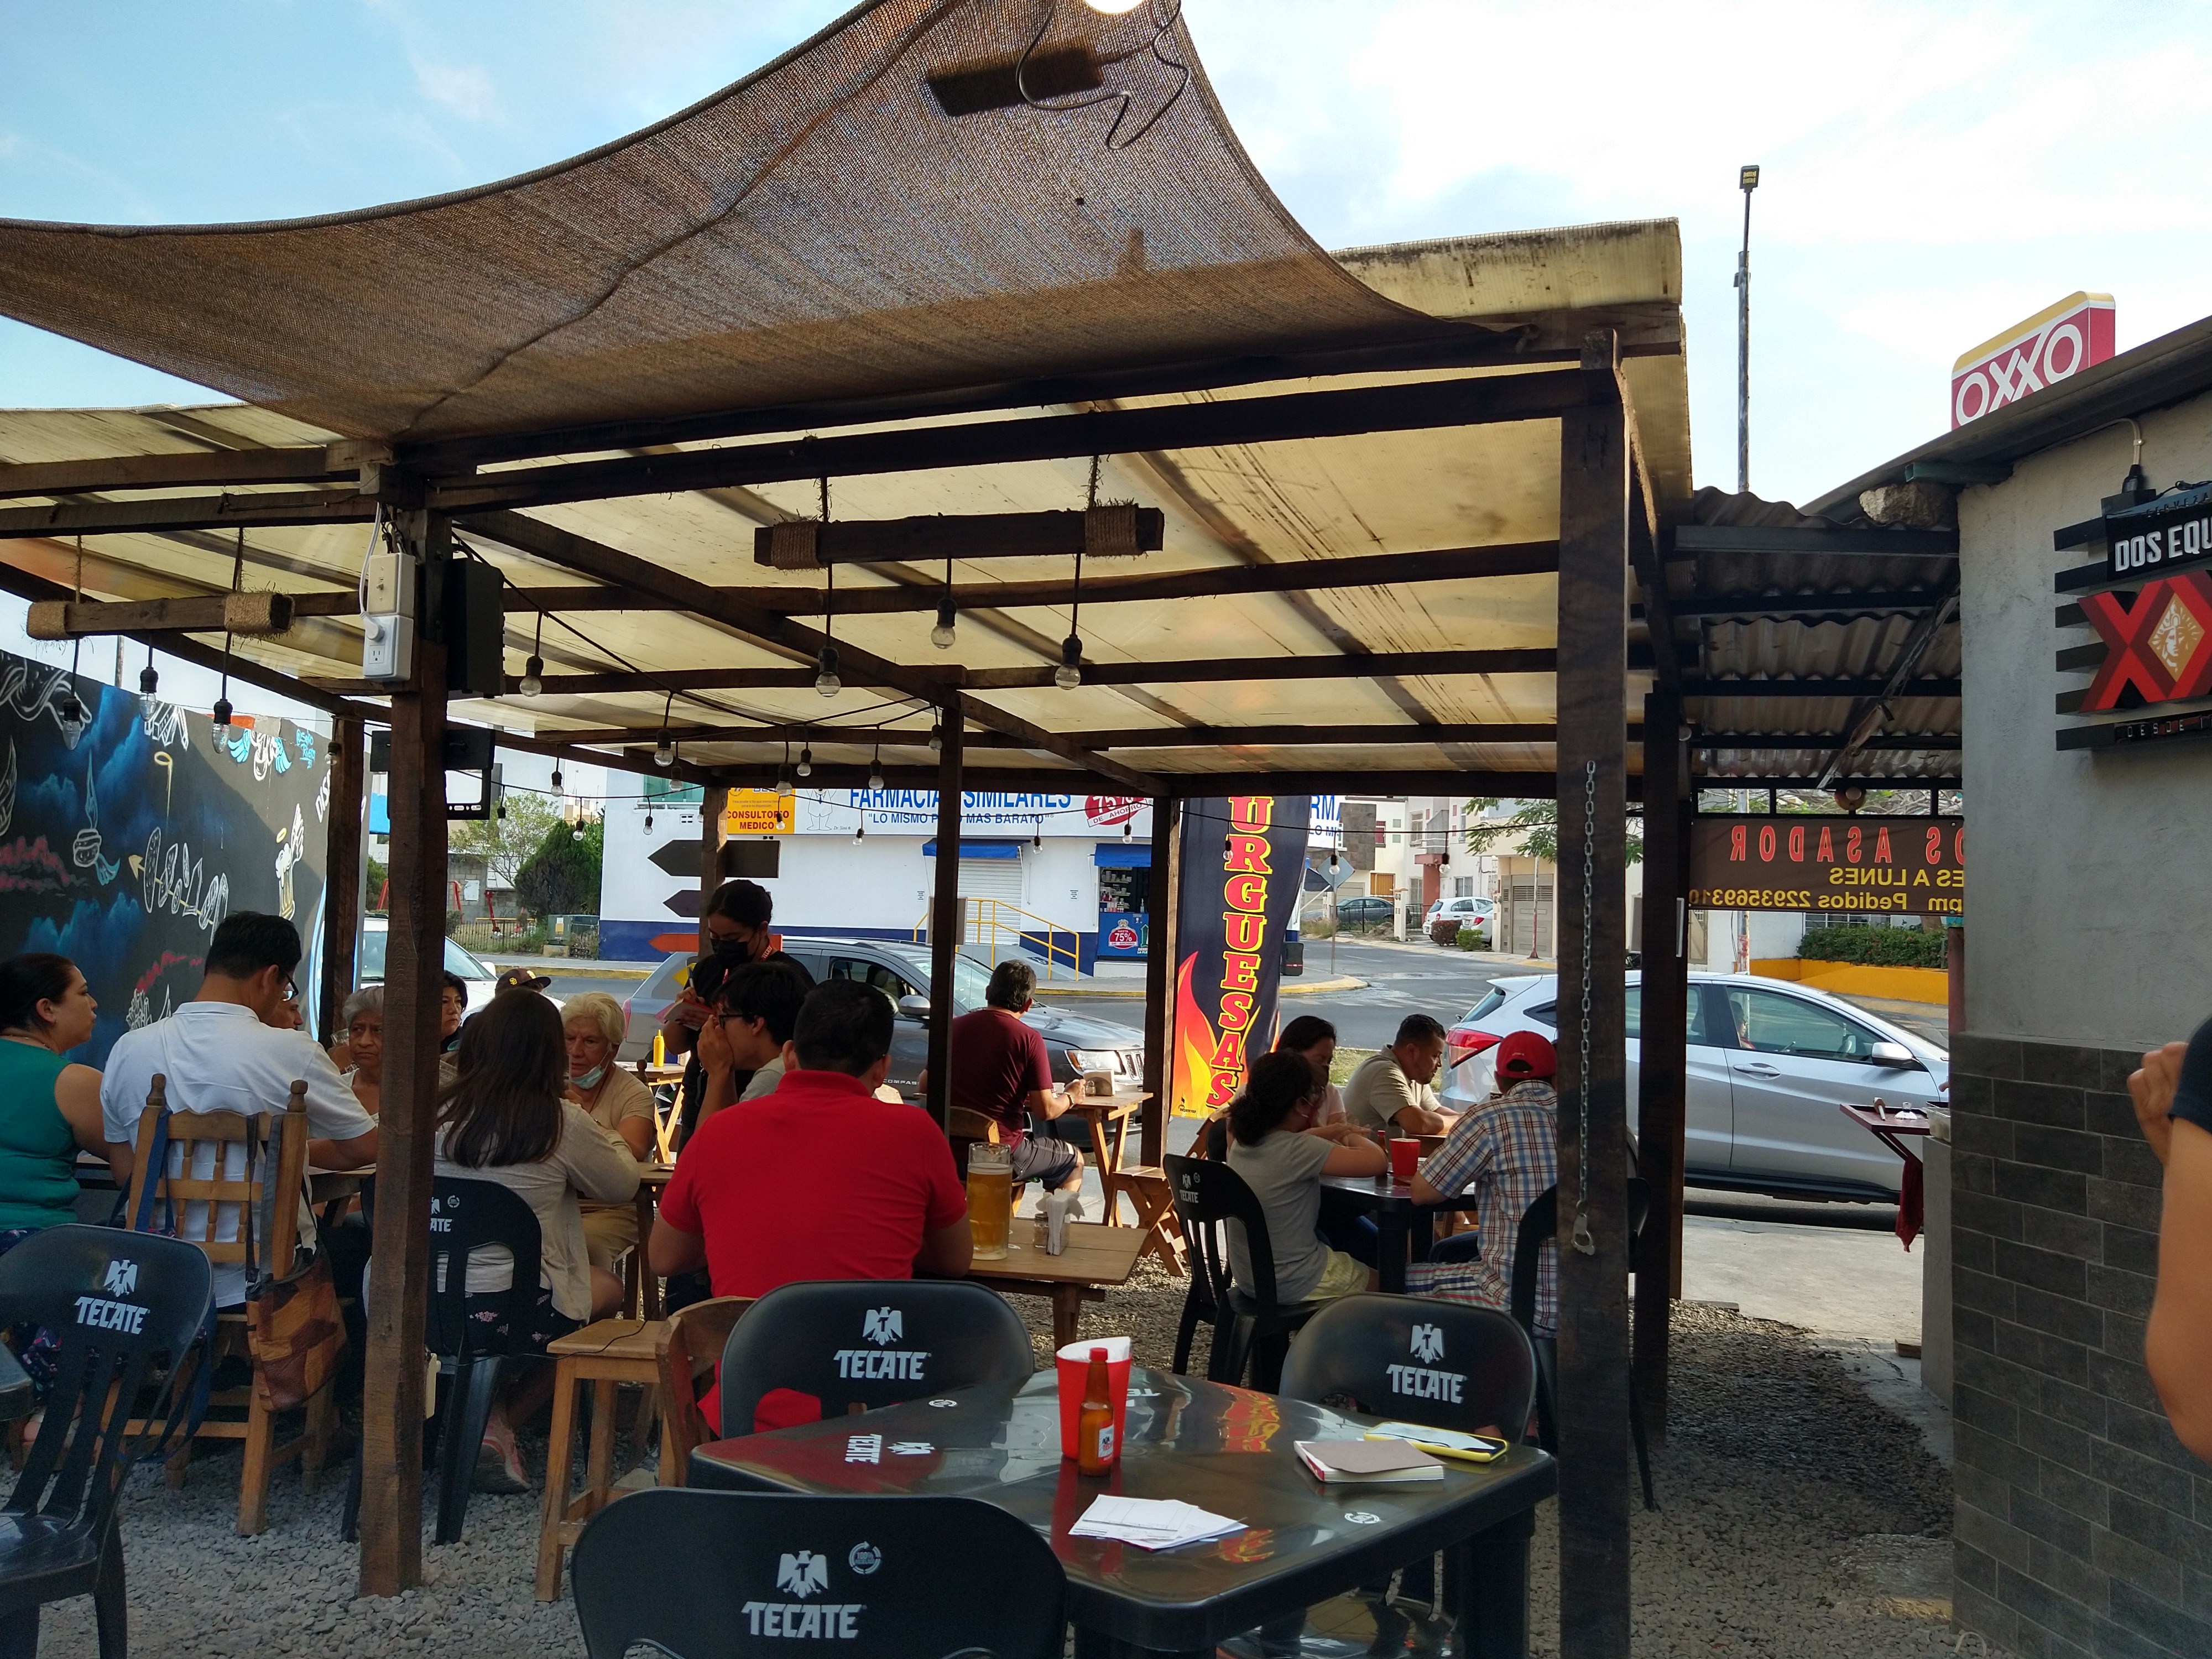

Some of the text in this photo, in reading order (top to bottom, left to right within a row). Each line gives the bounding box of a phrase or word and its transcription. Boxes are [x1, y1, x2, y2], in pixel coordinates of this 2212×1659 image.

[1956, 324, 2083, 426] OXXO
[2115, 531, 2161, 572] DOS
[963, 791, 1071, 808] SIMILARES
[1109, 804, 1142, 818] AHORRO
[891, 813, 927, 823] MISMO
[966, 813, 991, 823] MAS
[1114, 933, 1133, 941] 75%
[1179, 1189, 1199, 1203] TECATE
[74, 1296, 149, 1334] TECATE
[833, 1350, 928, 1380] TECATE
[1385, 1364, 1465, 1404] TECATE
[740, 1601, 862, 1639] TECATE
